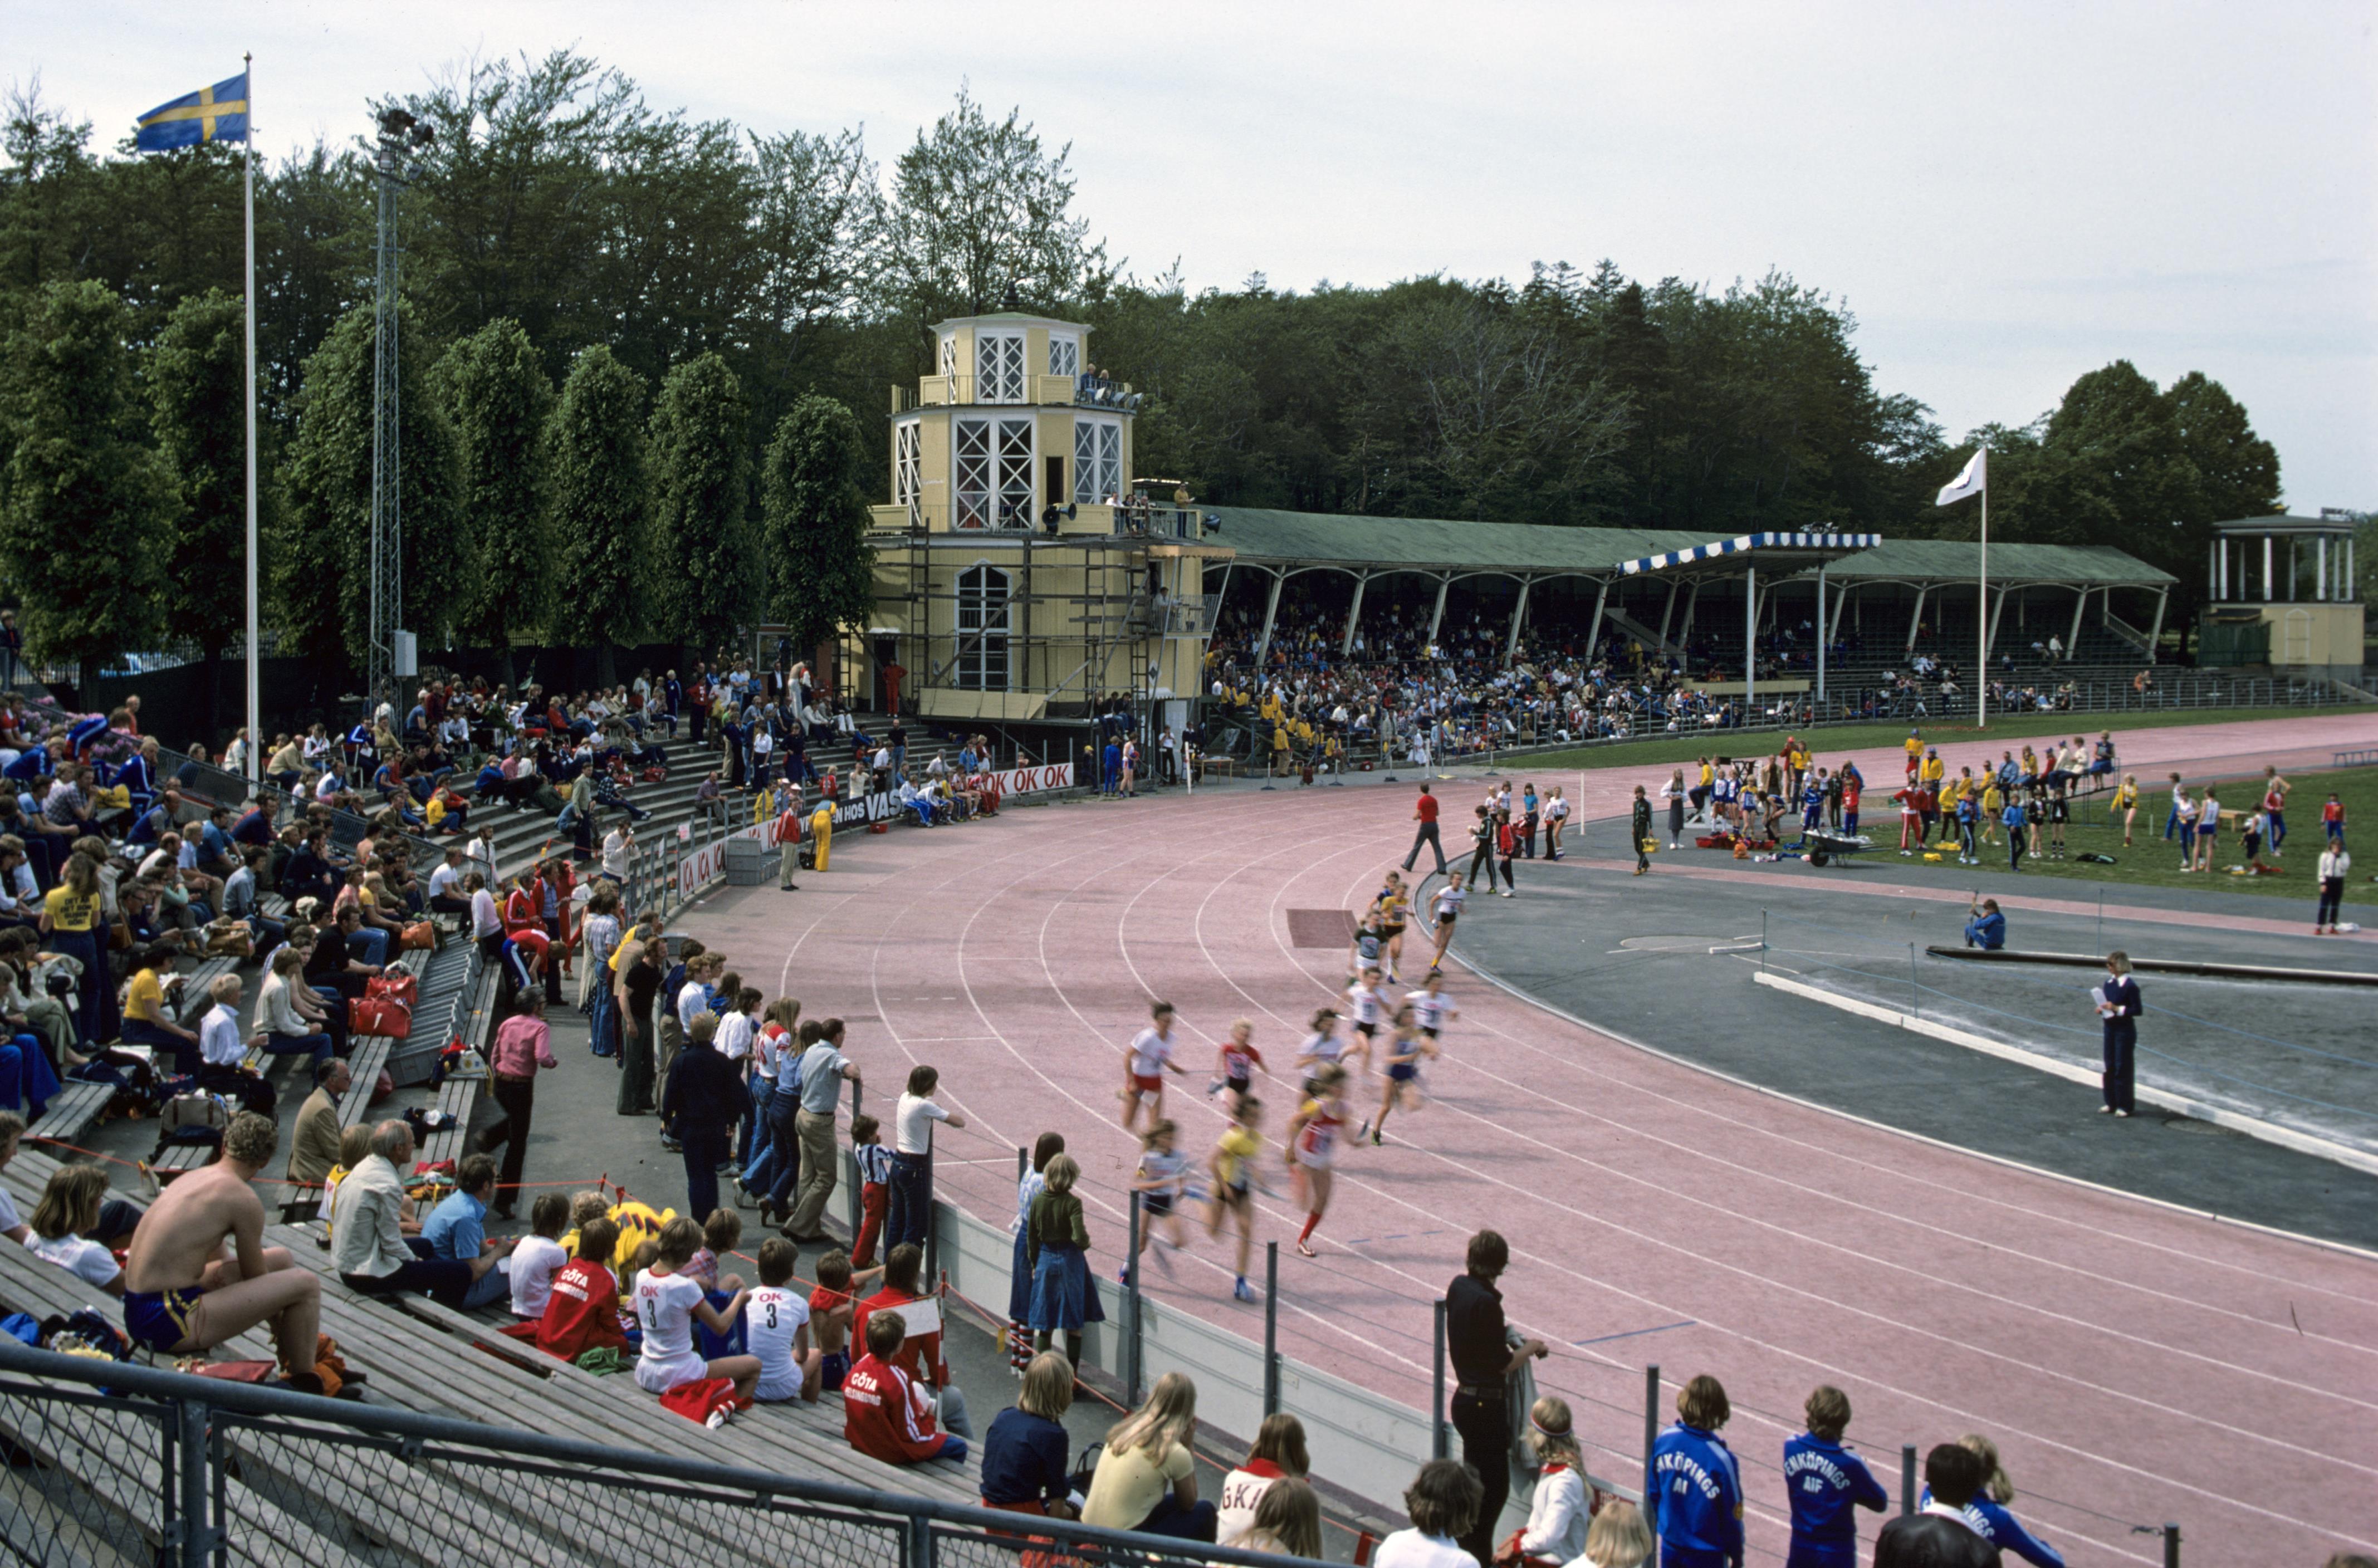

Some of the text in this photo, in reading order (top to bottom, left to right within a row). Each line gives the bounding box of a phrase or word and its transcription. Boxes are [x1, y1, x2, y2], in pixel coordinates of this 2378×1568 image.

[985, 772, 1008, 795] OK
[1014, 768, 1039, 792] OK
[1044, 765, 1069, 788] OK
[844, 802, 865, 822] HOS
[865, 788, 907, 821] VAS
[683, 861, 694, 893] ICA
[698, 852, 710, 883] ICA
[767, 821, 780, 850] IC
[561, 1268, 589, 1288] GÖTA
[641, 1286, 659, 1297] OK
[759, 1292, 782, 1302] OK
[648, 1300, 657, 1327] 3
[766, 1303, 777, 1329] 3
[850, 1371, 878, 1391] GÖTA
[1657, 1451, 1720, 1499] NKÖPINGS
[1784, 1451, 1851, 1490] ENKÖPINGS
[1803, 1476, 1823, 1493] AIF
